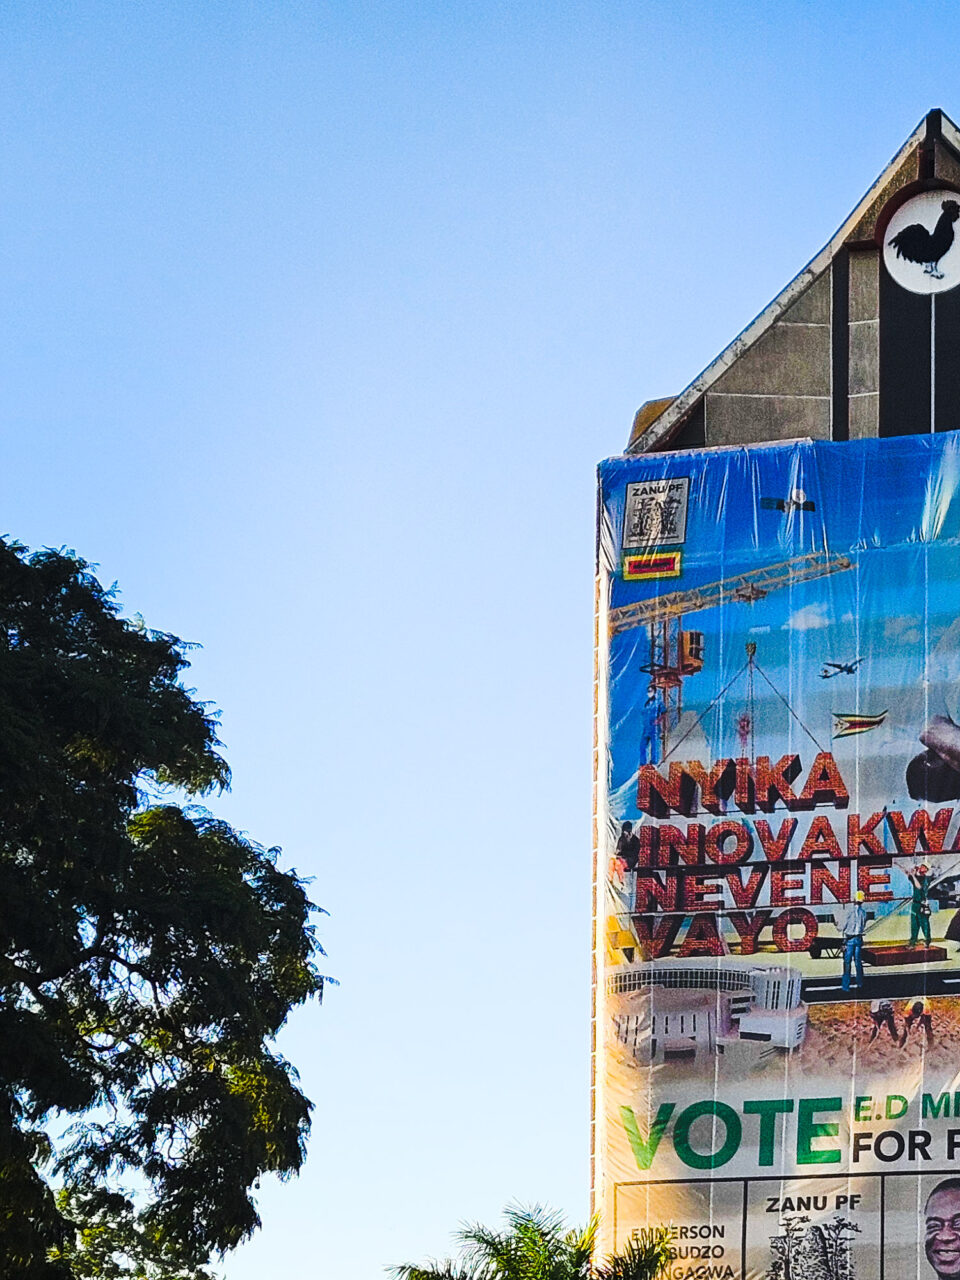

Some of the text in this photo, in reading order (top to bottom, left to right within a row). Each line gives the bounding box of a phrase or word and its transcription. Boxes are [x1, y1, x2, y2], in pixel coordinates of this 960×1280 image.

[632, 484, 683, 496] ZANU PF
[637, 752, 849, 814] NYIKA
[636, 859, 893, 912] NEVENE
[633, 908, 818, 958] VAYO
[854, 1094, 909, 1121] E.D
[620, 1097, 842, 1170] VOTE
[853, 1130, 932, 1163] FOR
[766, 1194, 862, 1213] ZANU PF
[667, 1245, 725, 1260] BUDZO
